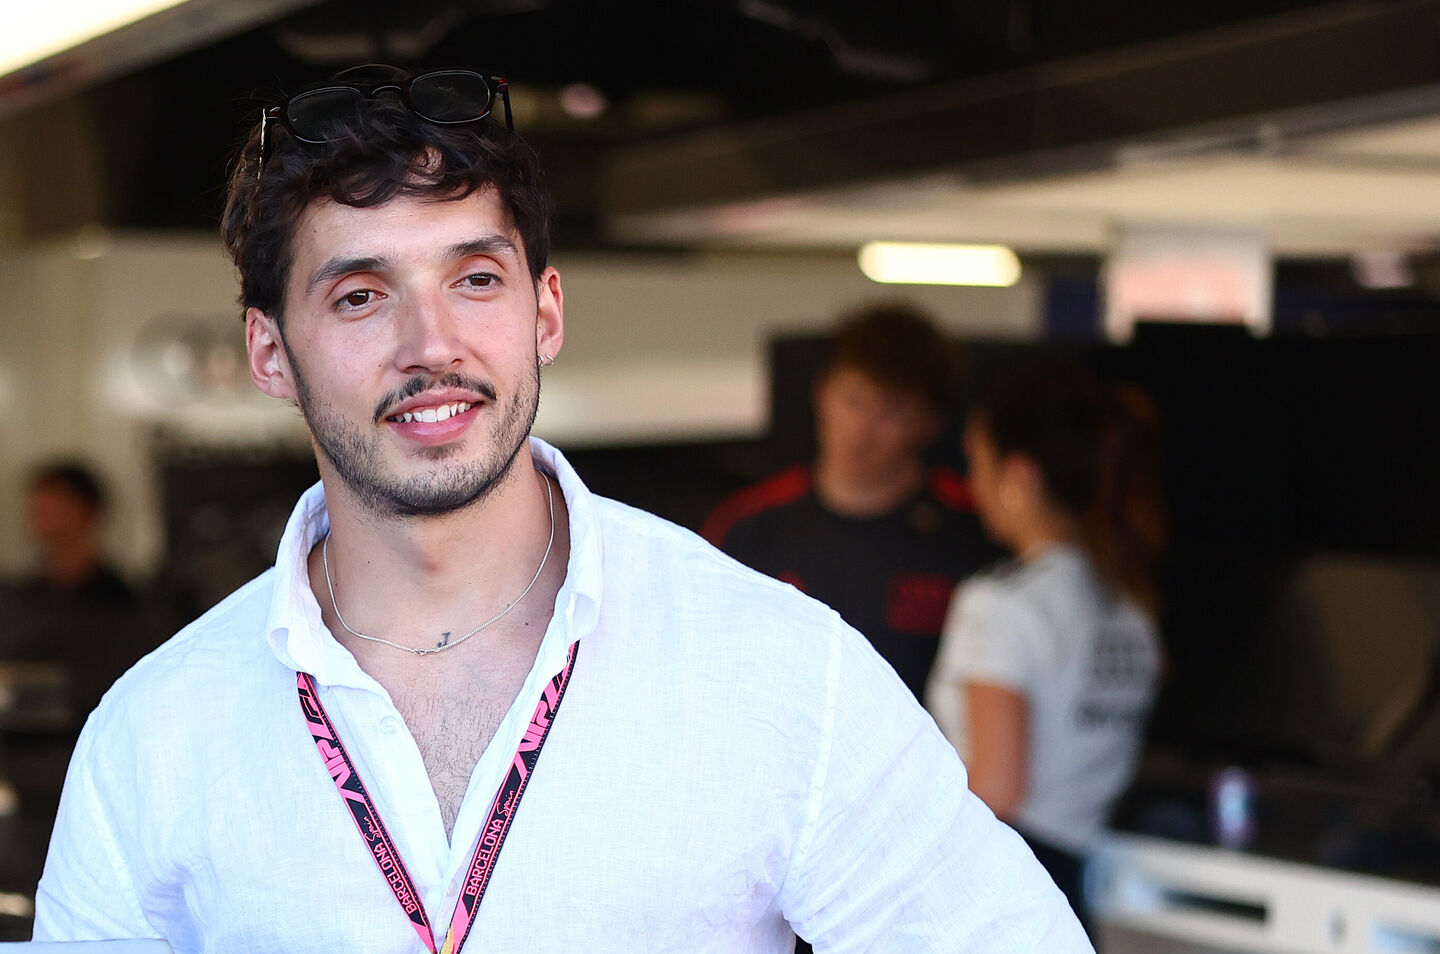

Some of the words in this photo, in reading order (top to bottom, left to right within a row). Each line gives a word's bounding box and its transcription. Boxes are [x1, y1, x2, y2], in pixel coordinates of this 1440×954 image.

[519, 699, 550, 752] VIP
[316, 738, 352, 789] VIP
[363, 815, 381, 842] Spain
[467, 819, 504, 896] BARCELONA
[497, 790, 515, 817] Spain
[374, 843, 417, 914] BARCELONA
